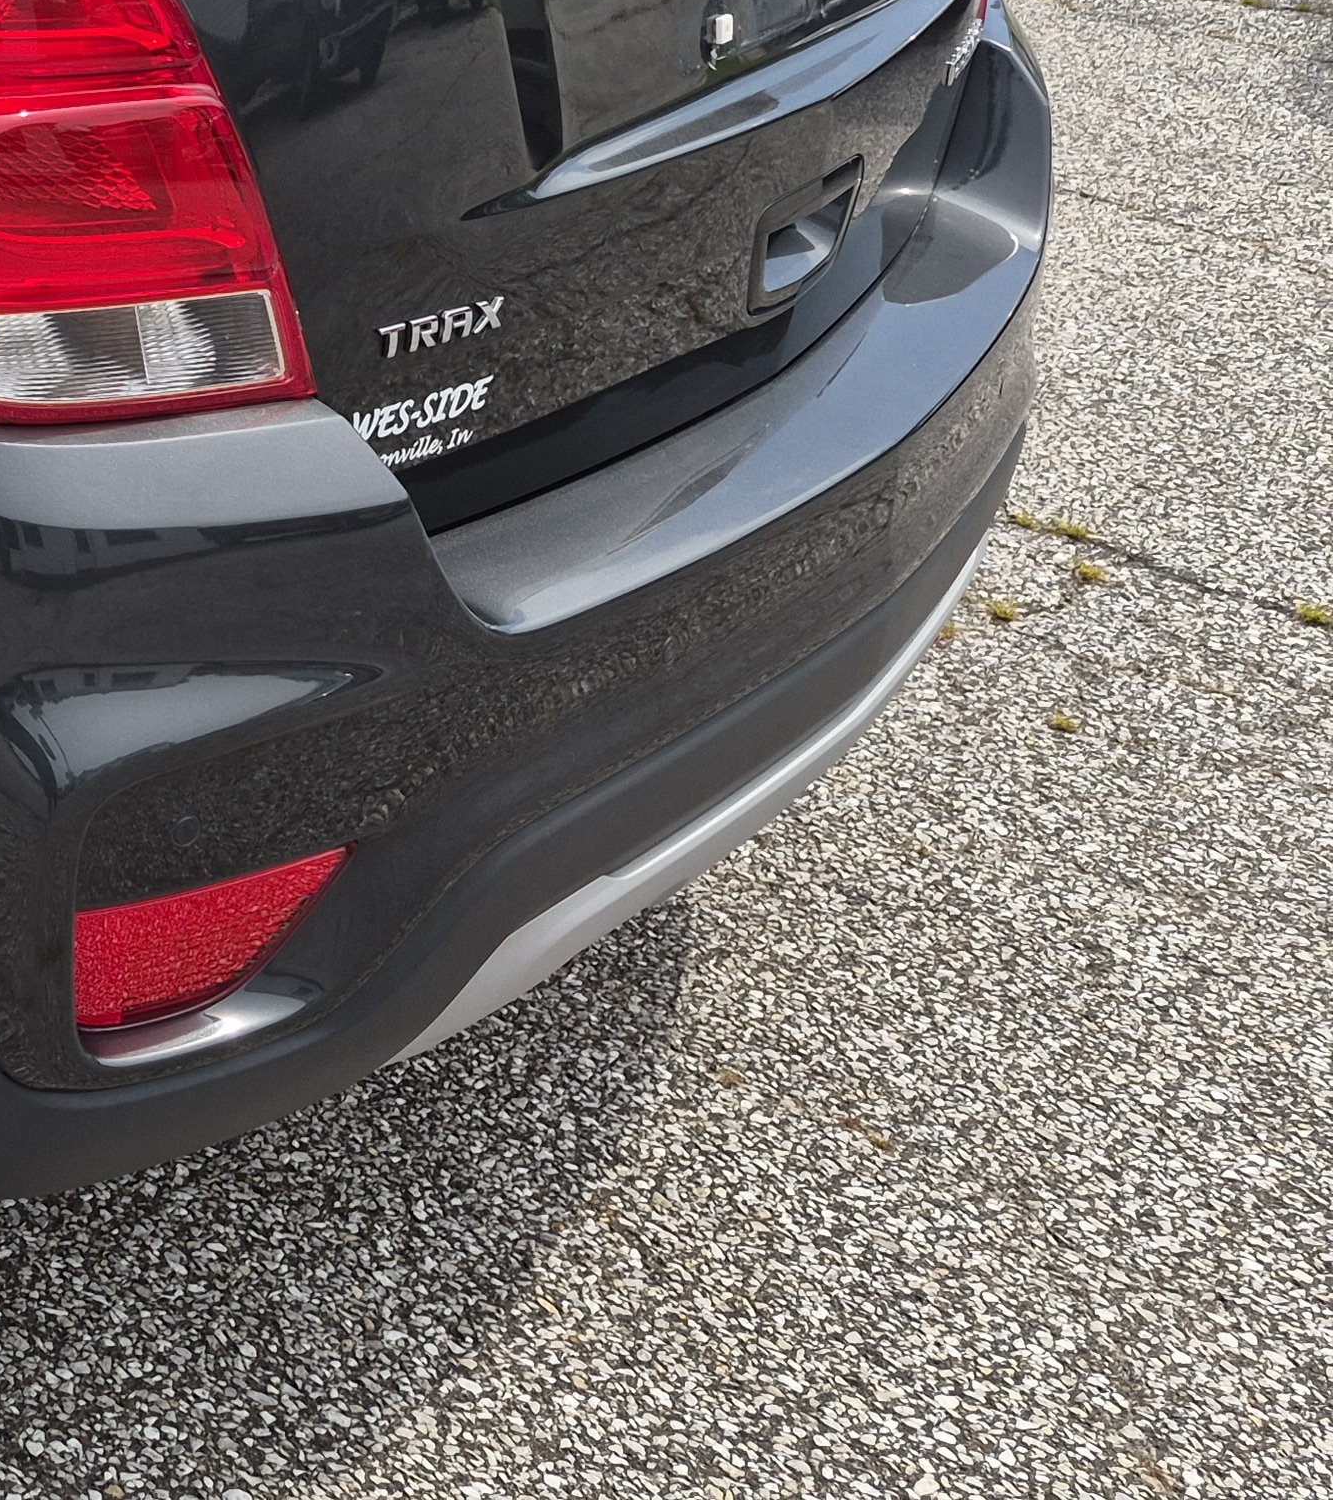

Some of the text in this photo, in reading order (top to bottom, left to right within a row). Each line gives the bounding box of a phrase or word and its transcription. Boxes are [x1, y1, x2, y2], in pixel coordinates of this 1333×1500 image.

[378, 296, 504, 358] TRAX
[353, 375, 494, 441] WES-SIDE
[446, 428, 473, 450] In
